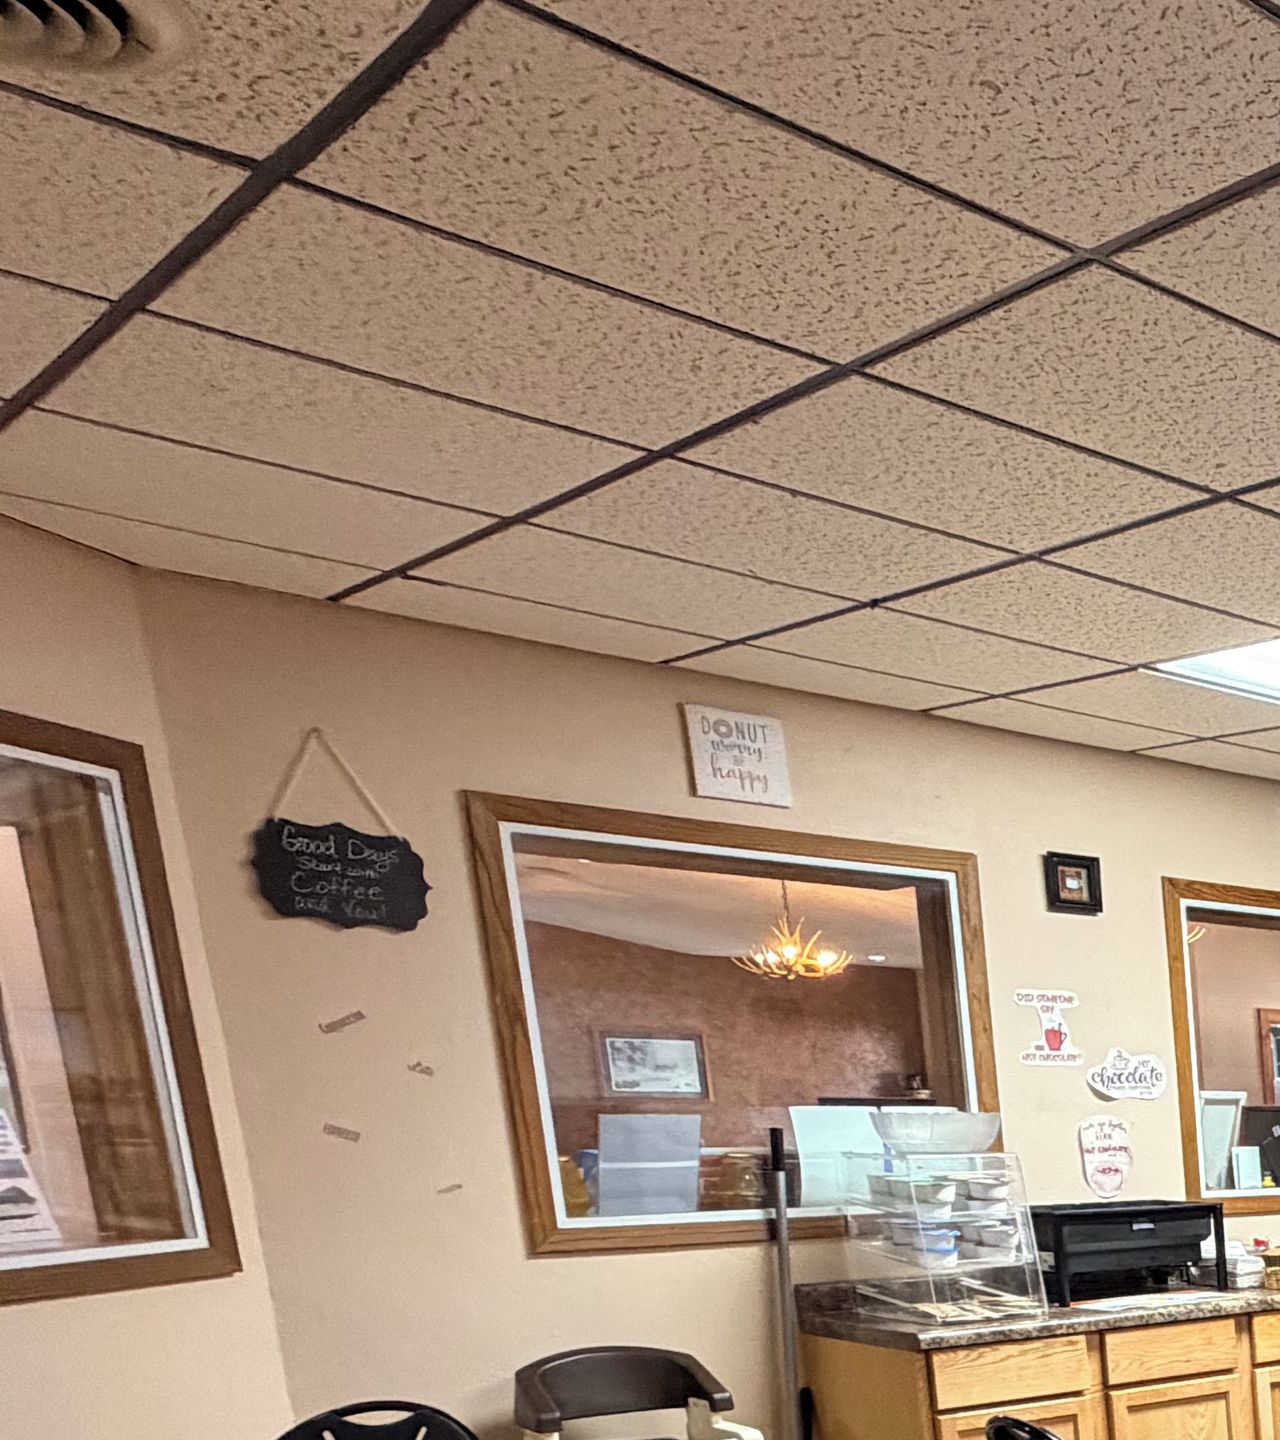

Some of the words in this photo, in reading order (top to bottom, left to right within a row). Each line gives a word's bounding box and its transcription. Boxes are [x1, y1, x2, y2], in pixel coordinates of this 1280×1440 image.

[700, 715, 768, 744] DONUT
[710, 752, 769, 794] happy
[291, 871, 385, 900] Coffee
[1091, 1065, 1163, 1091] chocolate
